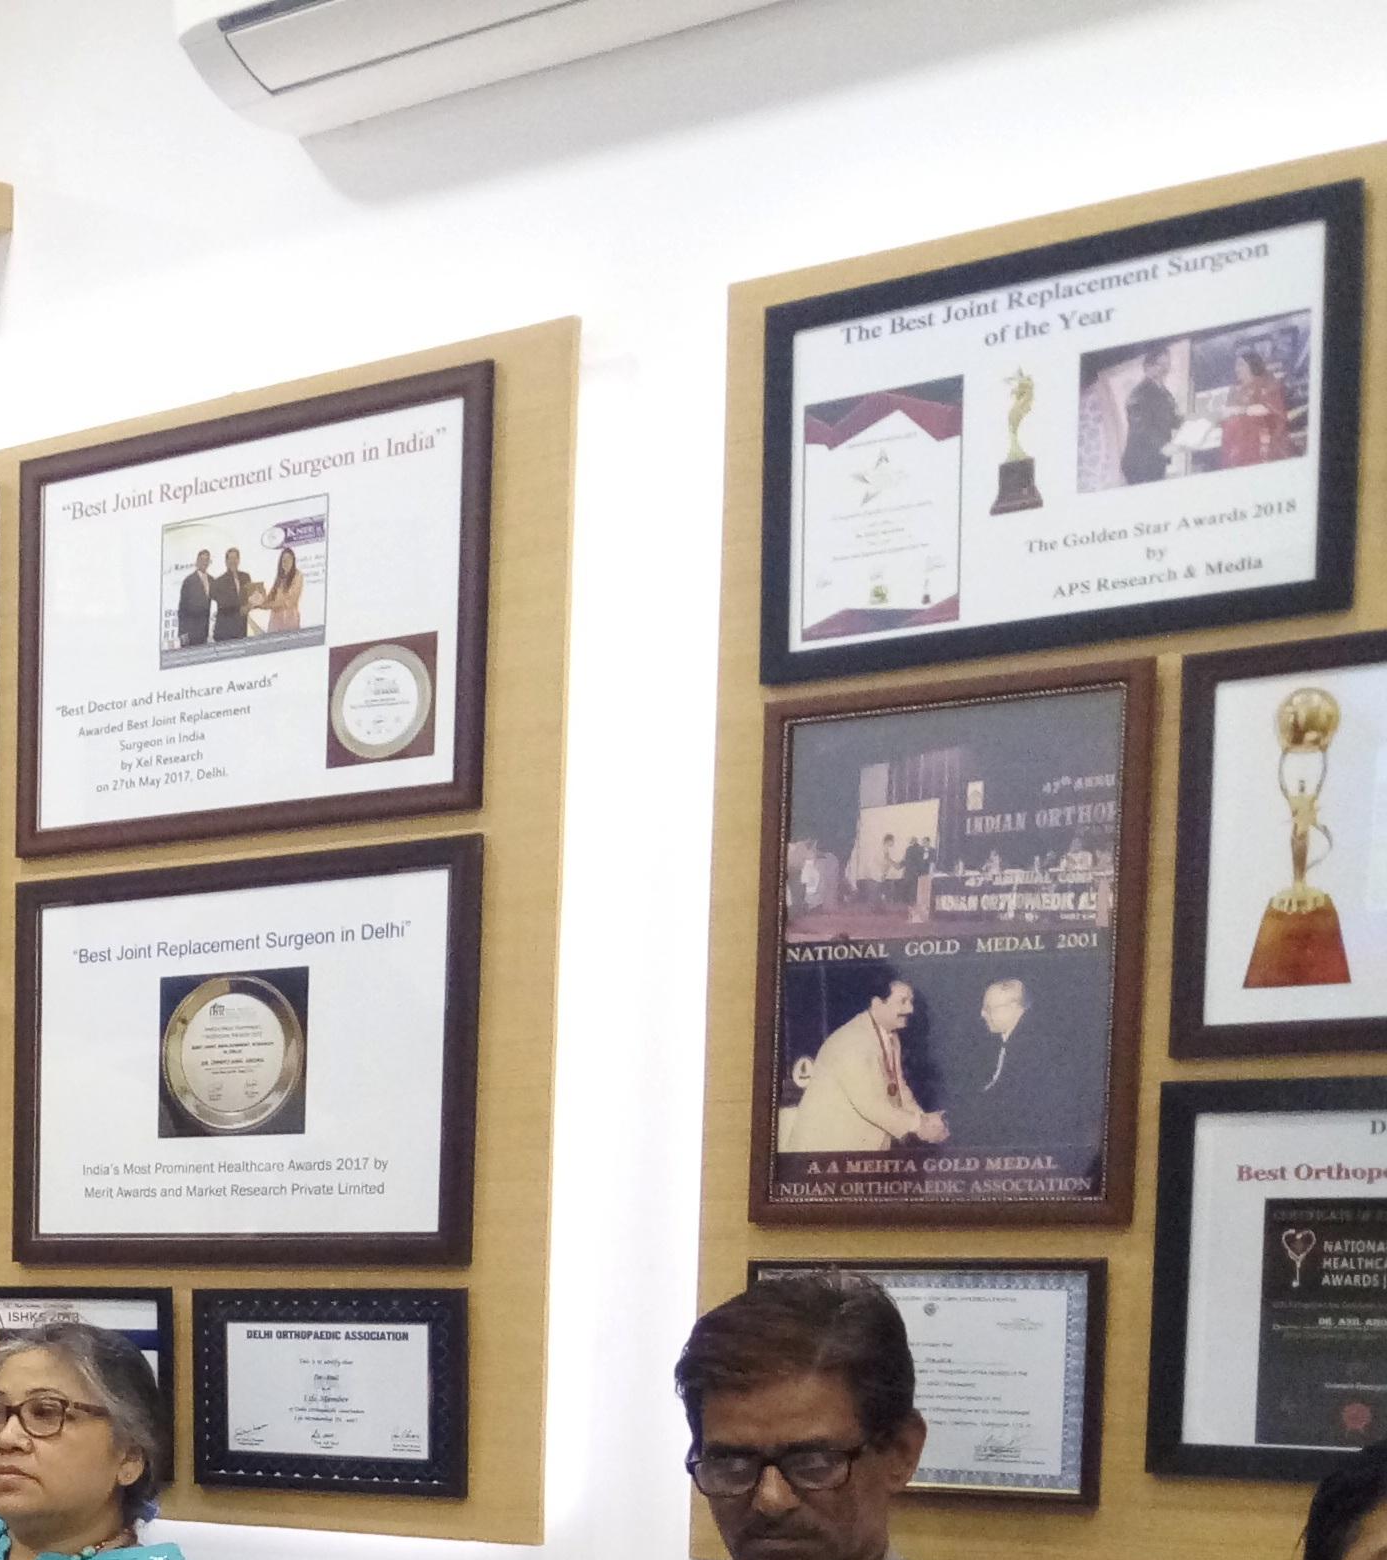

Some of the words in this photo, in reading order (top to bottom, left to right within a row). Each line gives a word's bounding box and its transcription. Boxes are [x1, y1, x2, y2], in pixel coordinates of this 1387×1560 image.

[841, 323, 882, 346] The
[889, 312, 936, 337] Best
[941, 298, 998, 325] Joint
[1006, 265, 1159, 314] Replacement
[1167, 242, 1270, 281] Surgeon
[984, 325, 1007, 347] of
[1015, 317, 1050, 342] the
[1057, 306, 1117, 333] Year
[113, 487, 154, 513] Joint
[159, 465, 274, 504] Replacement
[279, 447, 356, 480] Surgeon
[362, 441, 380, 463] in
[1026, 540, 1058, 554] The
[1063, 528, 1128, 548] Golden
[1133, 520, 1171, 537] Star
[1176, 508, 1248, 531] Awards
[1252, 499, 1297, 518] 2018
[1145, 546, 1167, 562] by
[1053, 582, 1091, 599] APS
[1097, 569, 1177, 592] Research
[1205, 556, 1263, 576] Media
[88, 698, 128, 714] Doctor
[131, 694, 153, 708] and
[156, 684, 224, 703] Healthcare
[78, 723, 124, 738] Awarded
[127, 719, 148, 731] Best
[151, 715, 177, 728] Joint
[180, 705, 251, 724] Replacement
[119, 738, 163, 753] Surgeon
[166, 735, 176, 745] in
[178, 731, 206, 743] India
[121, 758, 133, 772] by
[156, 750, 204, 766] Research
[96, 782, 109, 792] on
[112, 777, 136, 790] 27th
[139, 775, 161, 789] May
[116, 943, 152, 960] Joint
[156, 934, 261, 959] Replacement
[265, 928, 336, 950] Surgeon
[341, 926, 355, 942] in
[787, 944, 889, 963] NATIONAL
[905, 938, 961, 957] GOLD
[976, 935, 1045, 953] MEDAL
[1057, 933, 1098, 949] 2001
[123, 1163, 152, 1175] Most
[154, 1161, 215, 1175] Prominent
[218, 1160, 285, 1173] Healthcare
[288, 1158, 332, 1172] Awards
[336, 1157, 369, 1171] 2017
[374, 1158, 389, 1173] by
[846, 1159, 918, 1174] MEHTA
[923, 1158, 980, 1173] GOLD
[985, 1155, 1058, 1171] MEDAL
[1237, 1163, 1287, 1182] Best
[84, 1186, 114, 1199] Merit
[116, 1186, 157, 1199] Awards
[160, 1186, 183, 1198] and
[185, 1185, 228, 1198] Market
[230, 1184, 287, 1197] Research
[291, 1183, 334, 1196] Private
[337, 1182, 385, 1195] Limited
[840, 1180, 960, 1196] ORTHOPAEDIC
[970, 1176, 1091, 1193] ASSOCIATION
[1321, 1274, 1379, 1287] AWARDS
[246, 1330, 273, 1339] DELHI
[276, 1330, 341, 1340] ORTHOPAEDIC
[344, 1330, 409, 1341] ASSOCIATION
